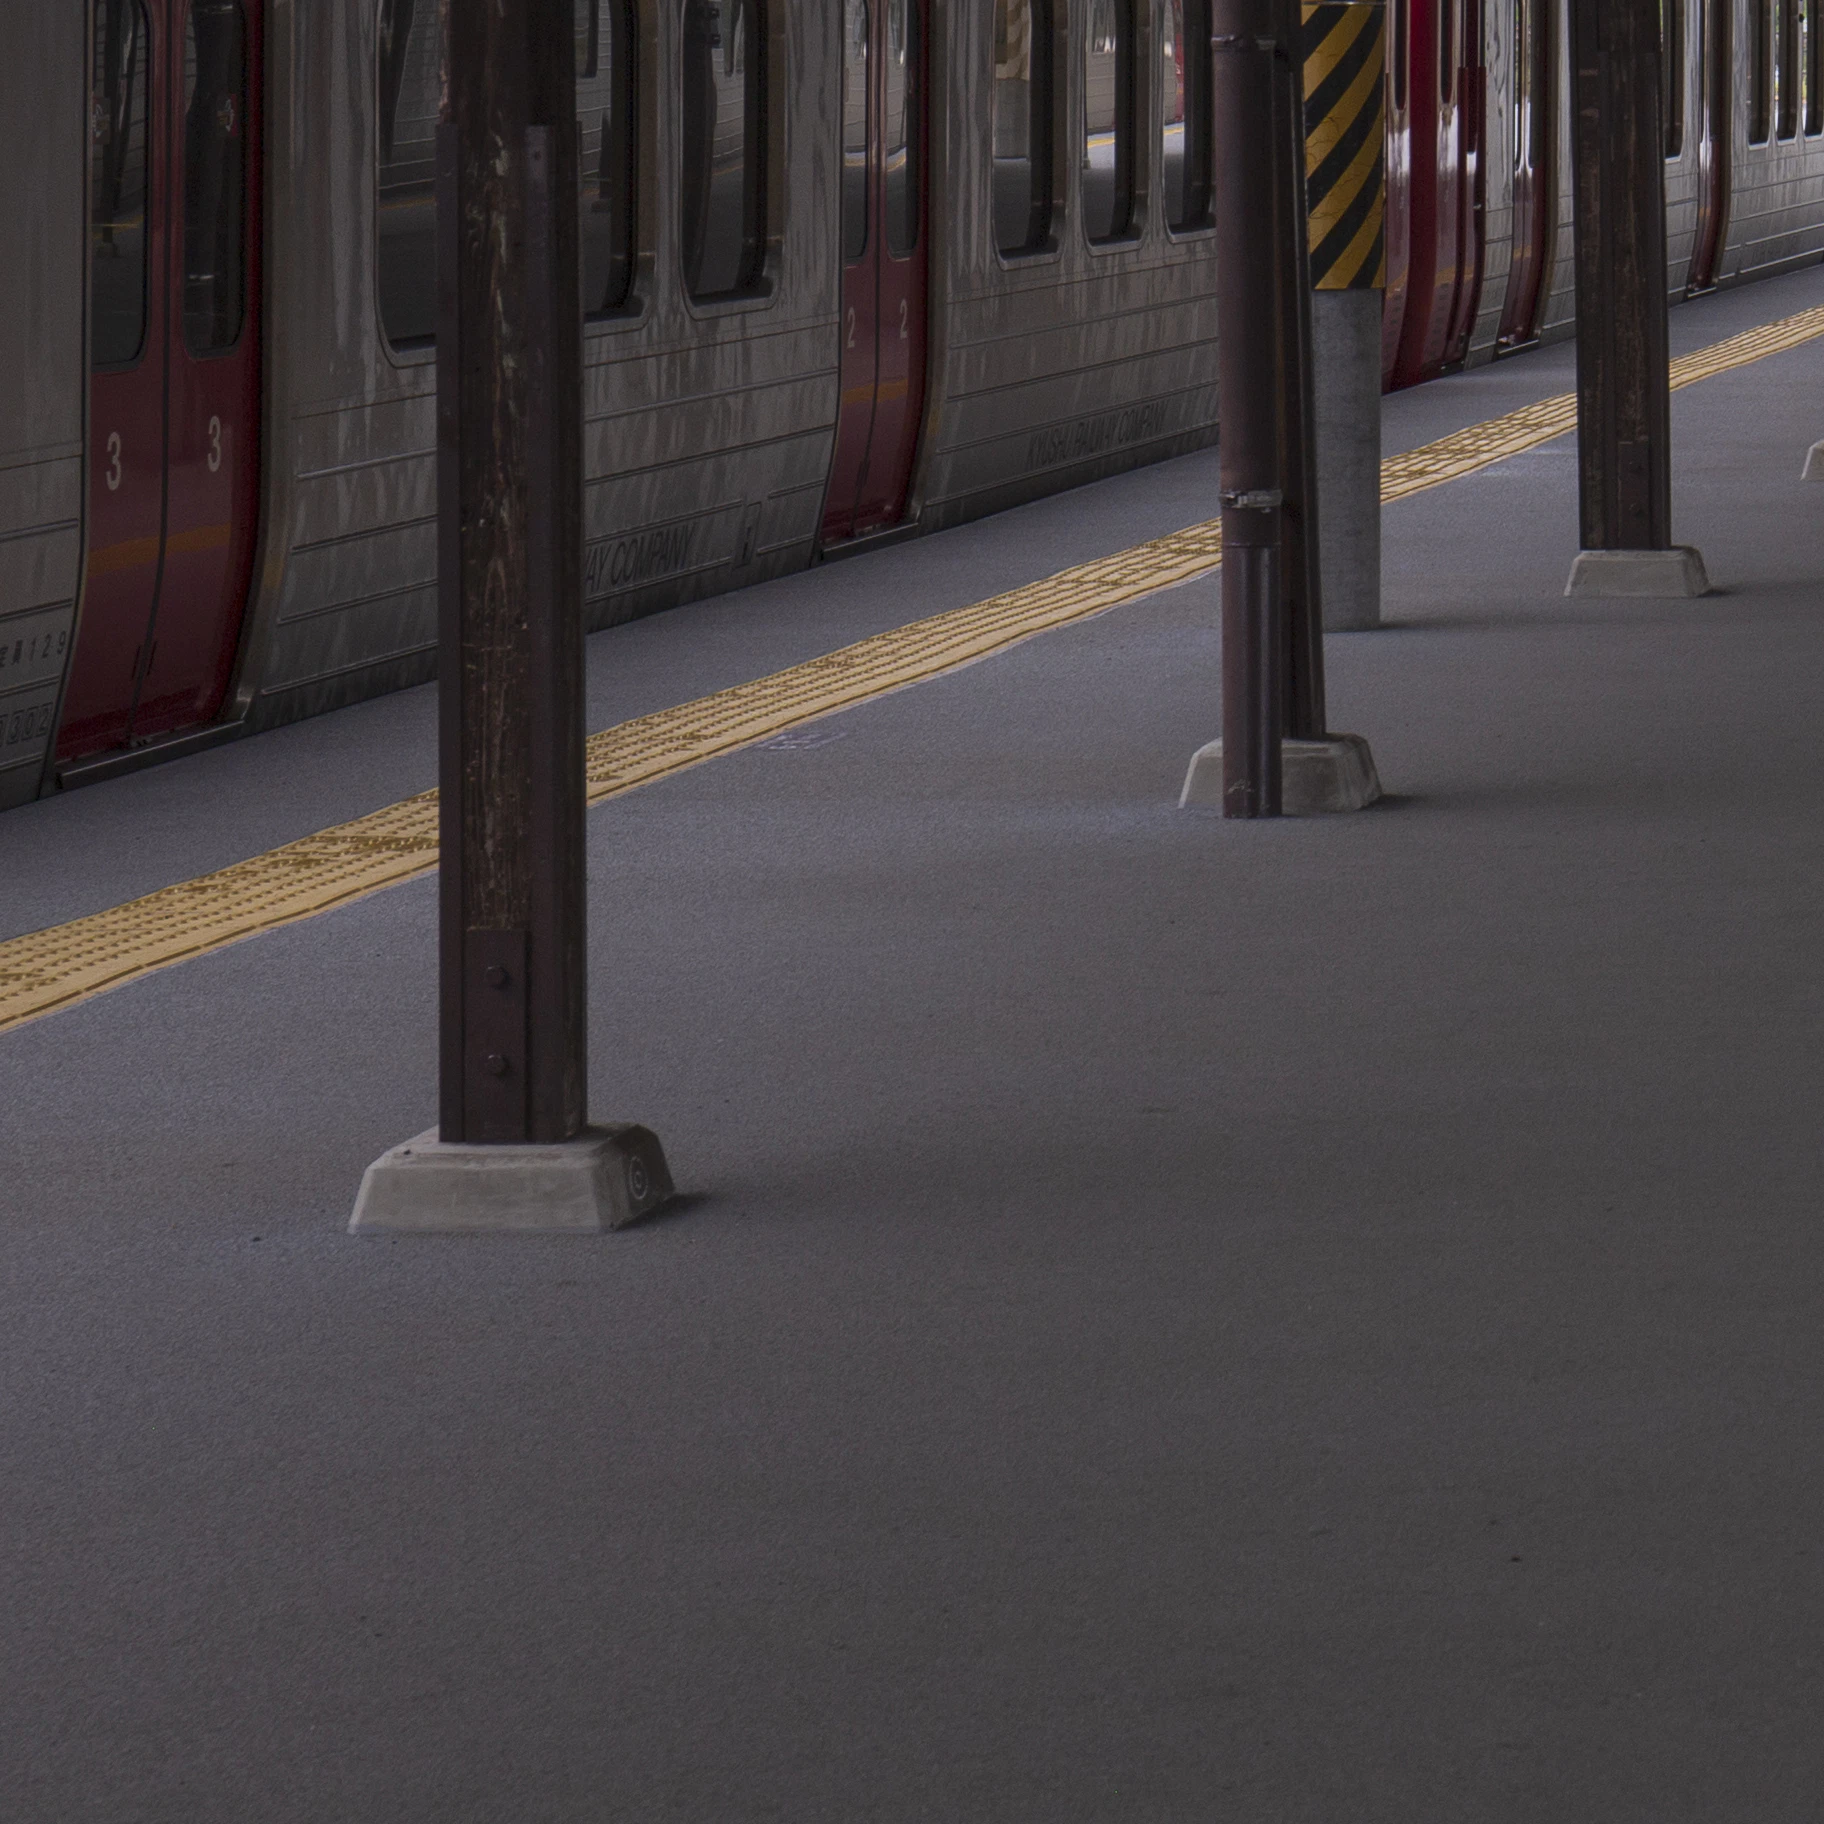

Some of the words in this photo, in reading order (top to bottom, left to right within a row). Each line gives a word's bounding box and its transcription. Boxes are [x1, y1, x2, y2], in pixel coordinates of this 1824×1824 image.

[847, 306, 856, 349] 2
[900, 298, 908, 340] 2
[106, 431, 122, 491] 3
[207, 415, 222, 472] 3
